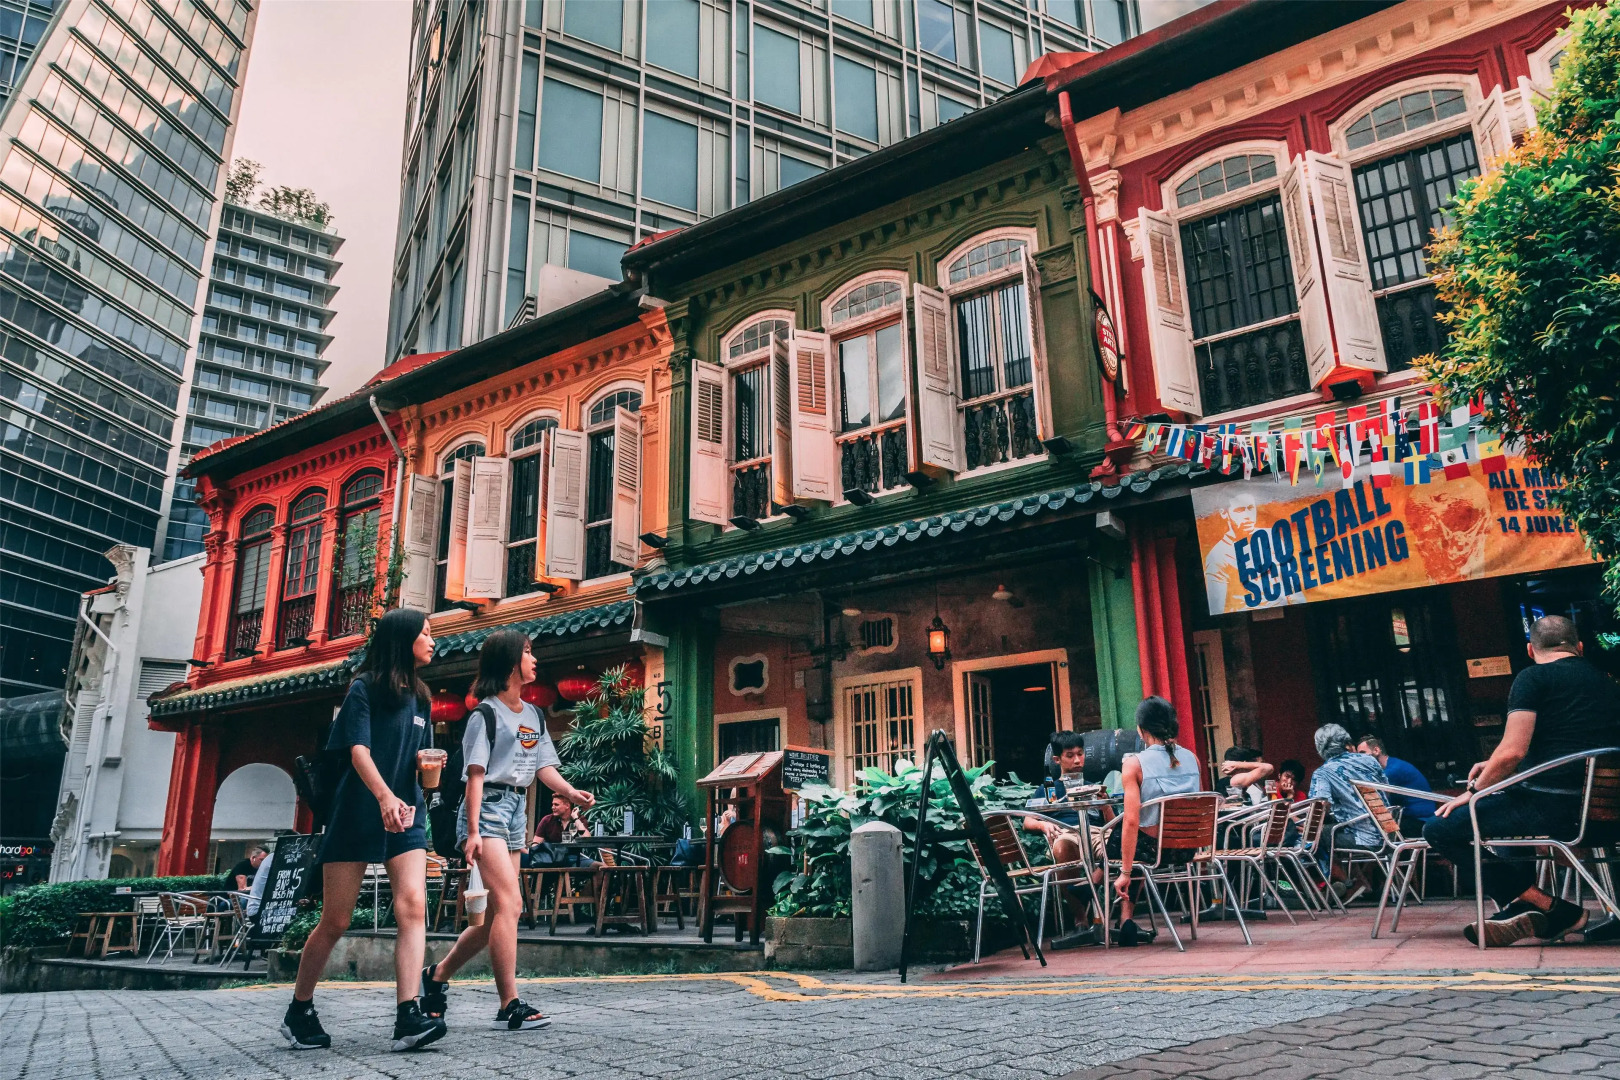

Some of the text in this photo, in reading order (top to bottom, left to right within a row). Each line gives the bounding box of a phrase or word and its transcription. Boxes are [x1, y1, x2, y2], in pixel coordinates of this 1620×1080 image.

[1488, 468, 1520, 489] ALL
[1503, 490, 1530, 511] BE
[1234, 480, 1391, 583] FOOTBALL
[1497, 515, 1575, 533] 14 JUNE
[1242, 519, 1410, 607] SCREENING
[657, 681, 672, 714] 5
[277, 869, 291, 880] FROM
